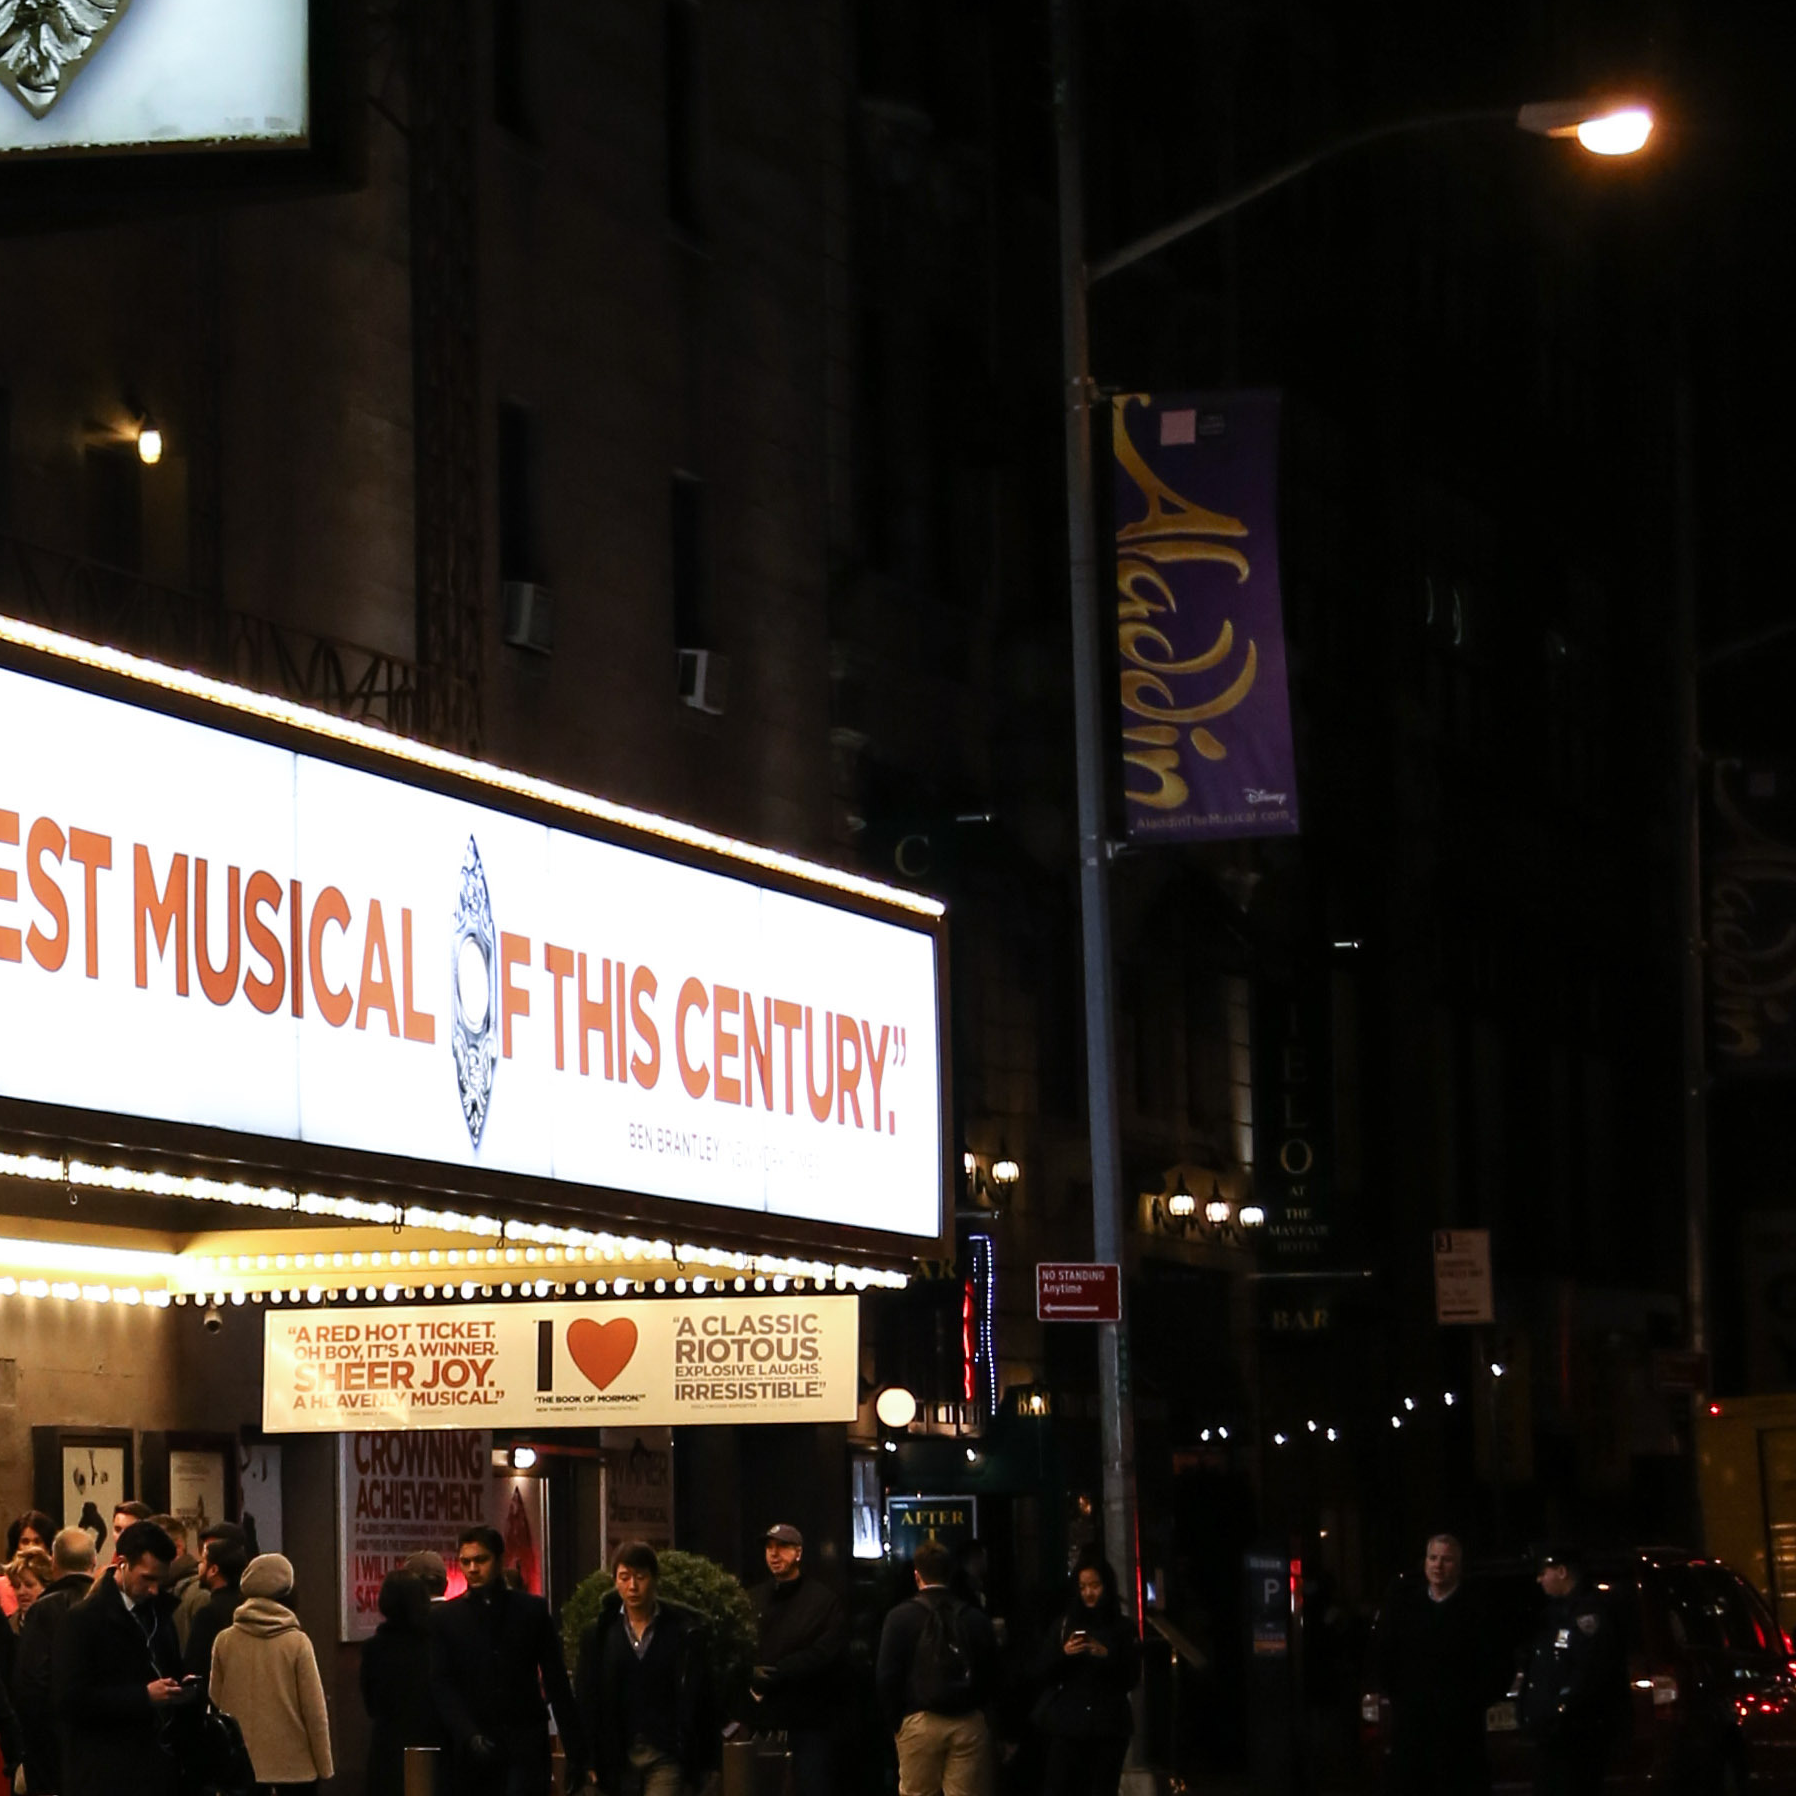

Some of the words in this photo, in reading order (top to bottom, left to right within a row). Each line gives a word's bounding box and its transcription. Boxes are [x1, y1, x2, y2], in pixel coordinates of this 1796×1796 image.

[133, 843, 436, 1044] MUSICAL
[544, 943, 661, 1090] THIS
[629, 1122, 653, 1150] BEN
[657, 1127, 720, 1162] BRANTLEY
[1042, 1270, 1056, 1281] NO
[1058, 1270, 1105, 1281] STANDING
[1043, 1283, 1083, 1295] Anytime
[1273, 1310, 1329, 1331] BAR
[316, 1325, 360, 1343] RED
[365, 1323, 411, 1342] HOT
[416, 1321, 496, 1340] TICKET.
[294, 1345, 321, 1361] OH
[404, 1343, 417, 1358] A
[293, 1360, 415, 1393] SHEER
[421, 1358, 496, 1390] JOY.
[675, 1365, 754, 1377] EXPLOSIVE
[293, 1394, 306, 1409] A
[556, 1395, 581, 1404] BOOK
[583, 1395, 595, 1403] OF
[354, 1430, 484, 1479] CROWNING
[901, 1510, 964, 1525] AFTER
[1264, 1578, 1281, 1604] P
